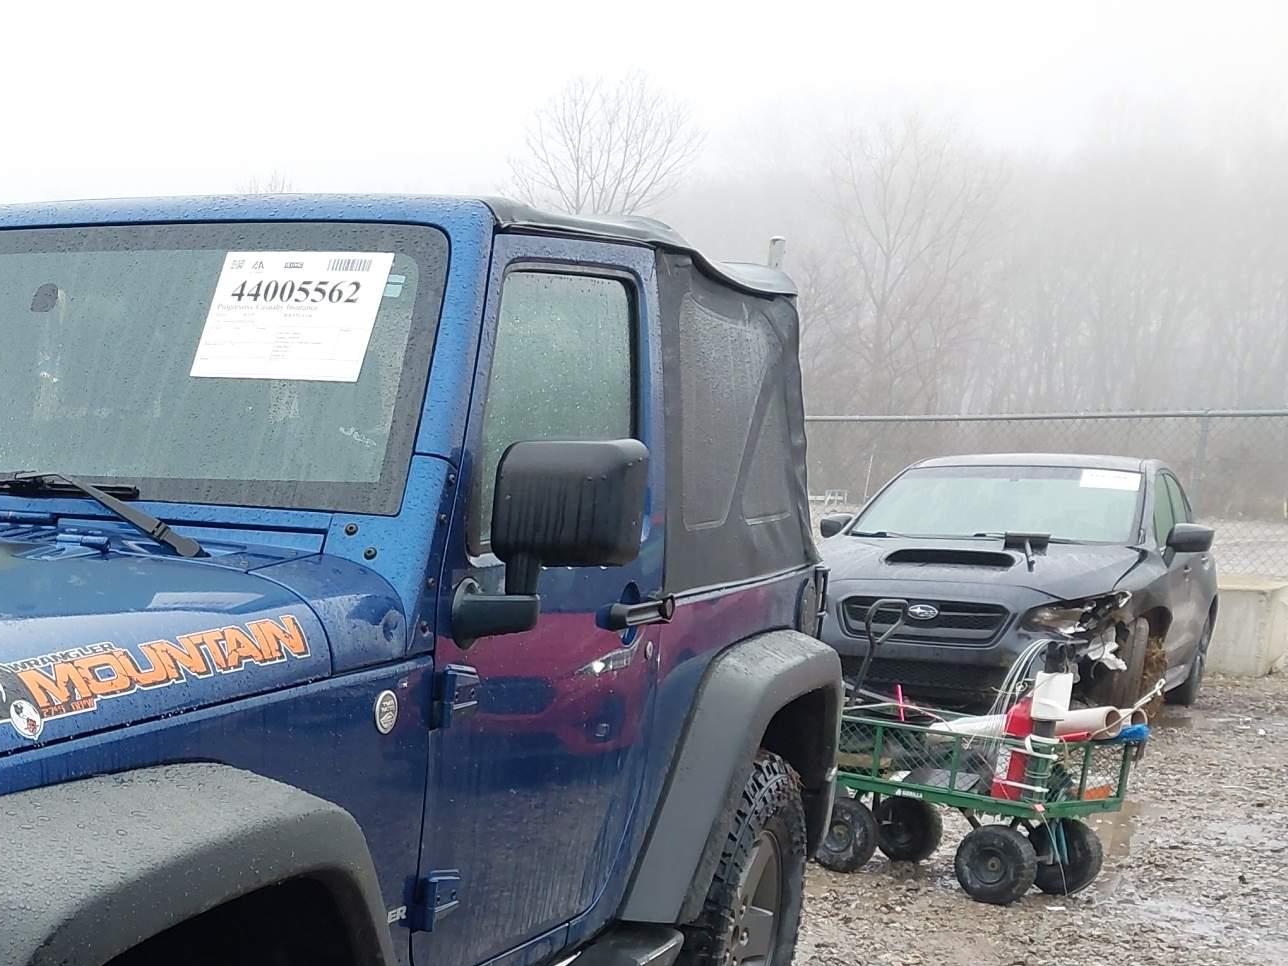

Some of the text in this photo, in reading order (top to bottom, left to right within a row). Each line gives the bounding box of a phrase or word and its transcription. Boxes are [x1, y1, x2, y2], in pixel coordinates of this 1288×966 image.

[231, 280, 362, 303] 44005562
[9, 643, 116, 673] WRANGLER
[16, 615, 310, 709] MOUNTAIN
